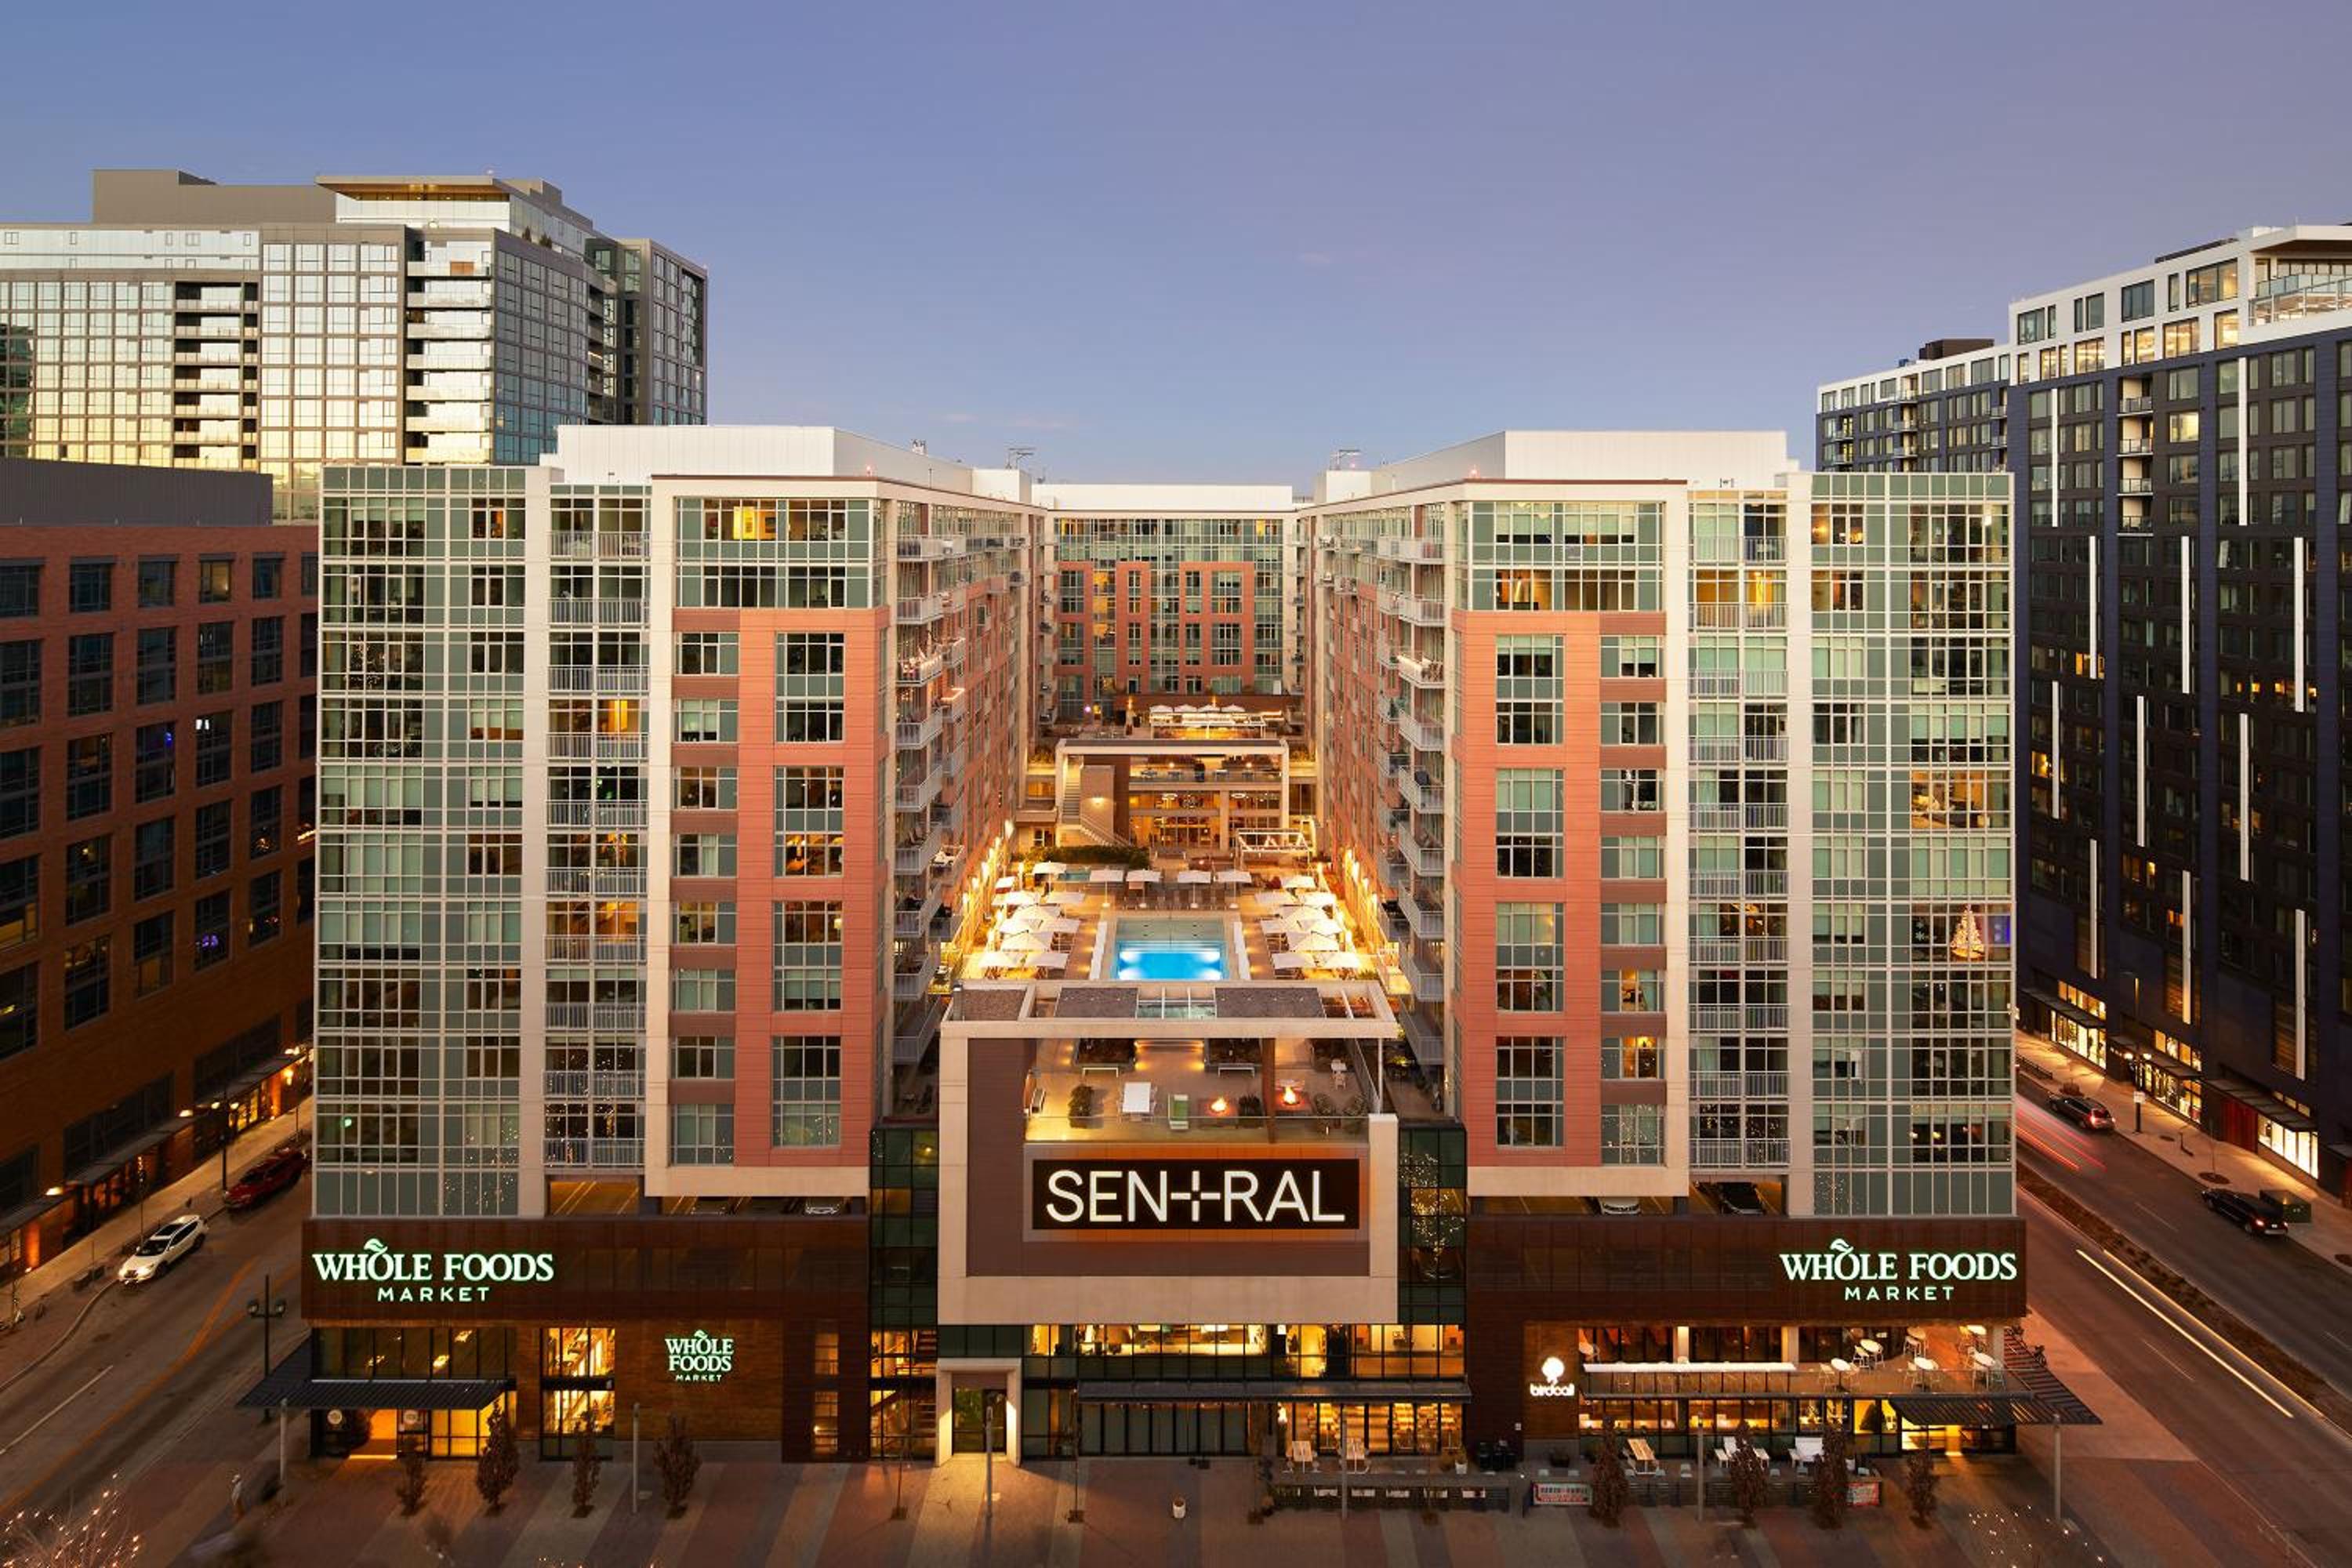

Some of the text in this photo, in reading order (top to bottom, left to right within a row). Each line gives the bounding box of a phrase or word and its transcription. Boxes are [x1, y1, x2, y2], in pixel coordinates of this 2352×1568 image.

[312, 1253, 555, 1281] WHOLE FOODS
[1779, 1253, 2018, 1281] WHOLE FOODS
[377, 1287, 490, 1302] MARKET
[1844, 1286, 1955, 1301] MARKET
[664, 1338, 734, 1355] WHOLE
[669, 1356, 731, 1372] FOODS
[675, 1374, 722, 1382] MARKET
